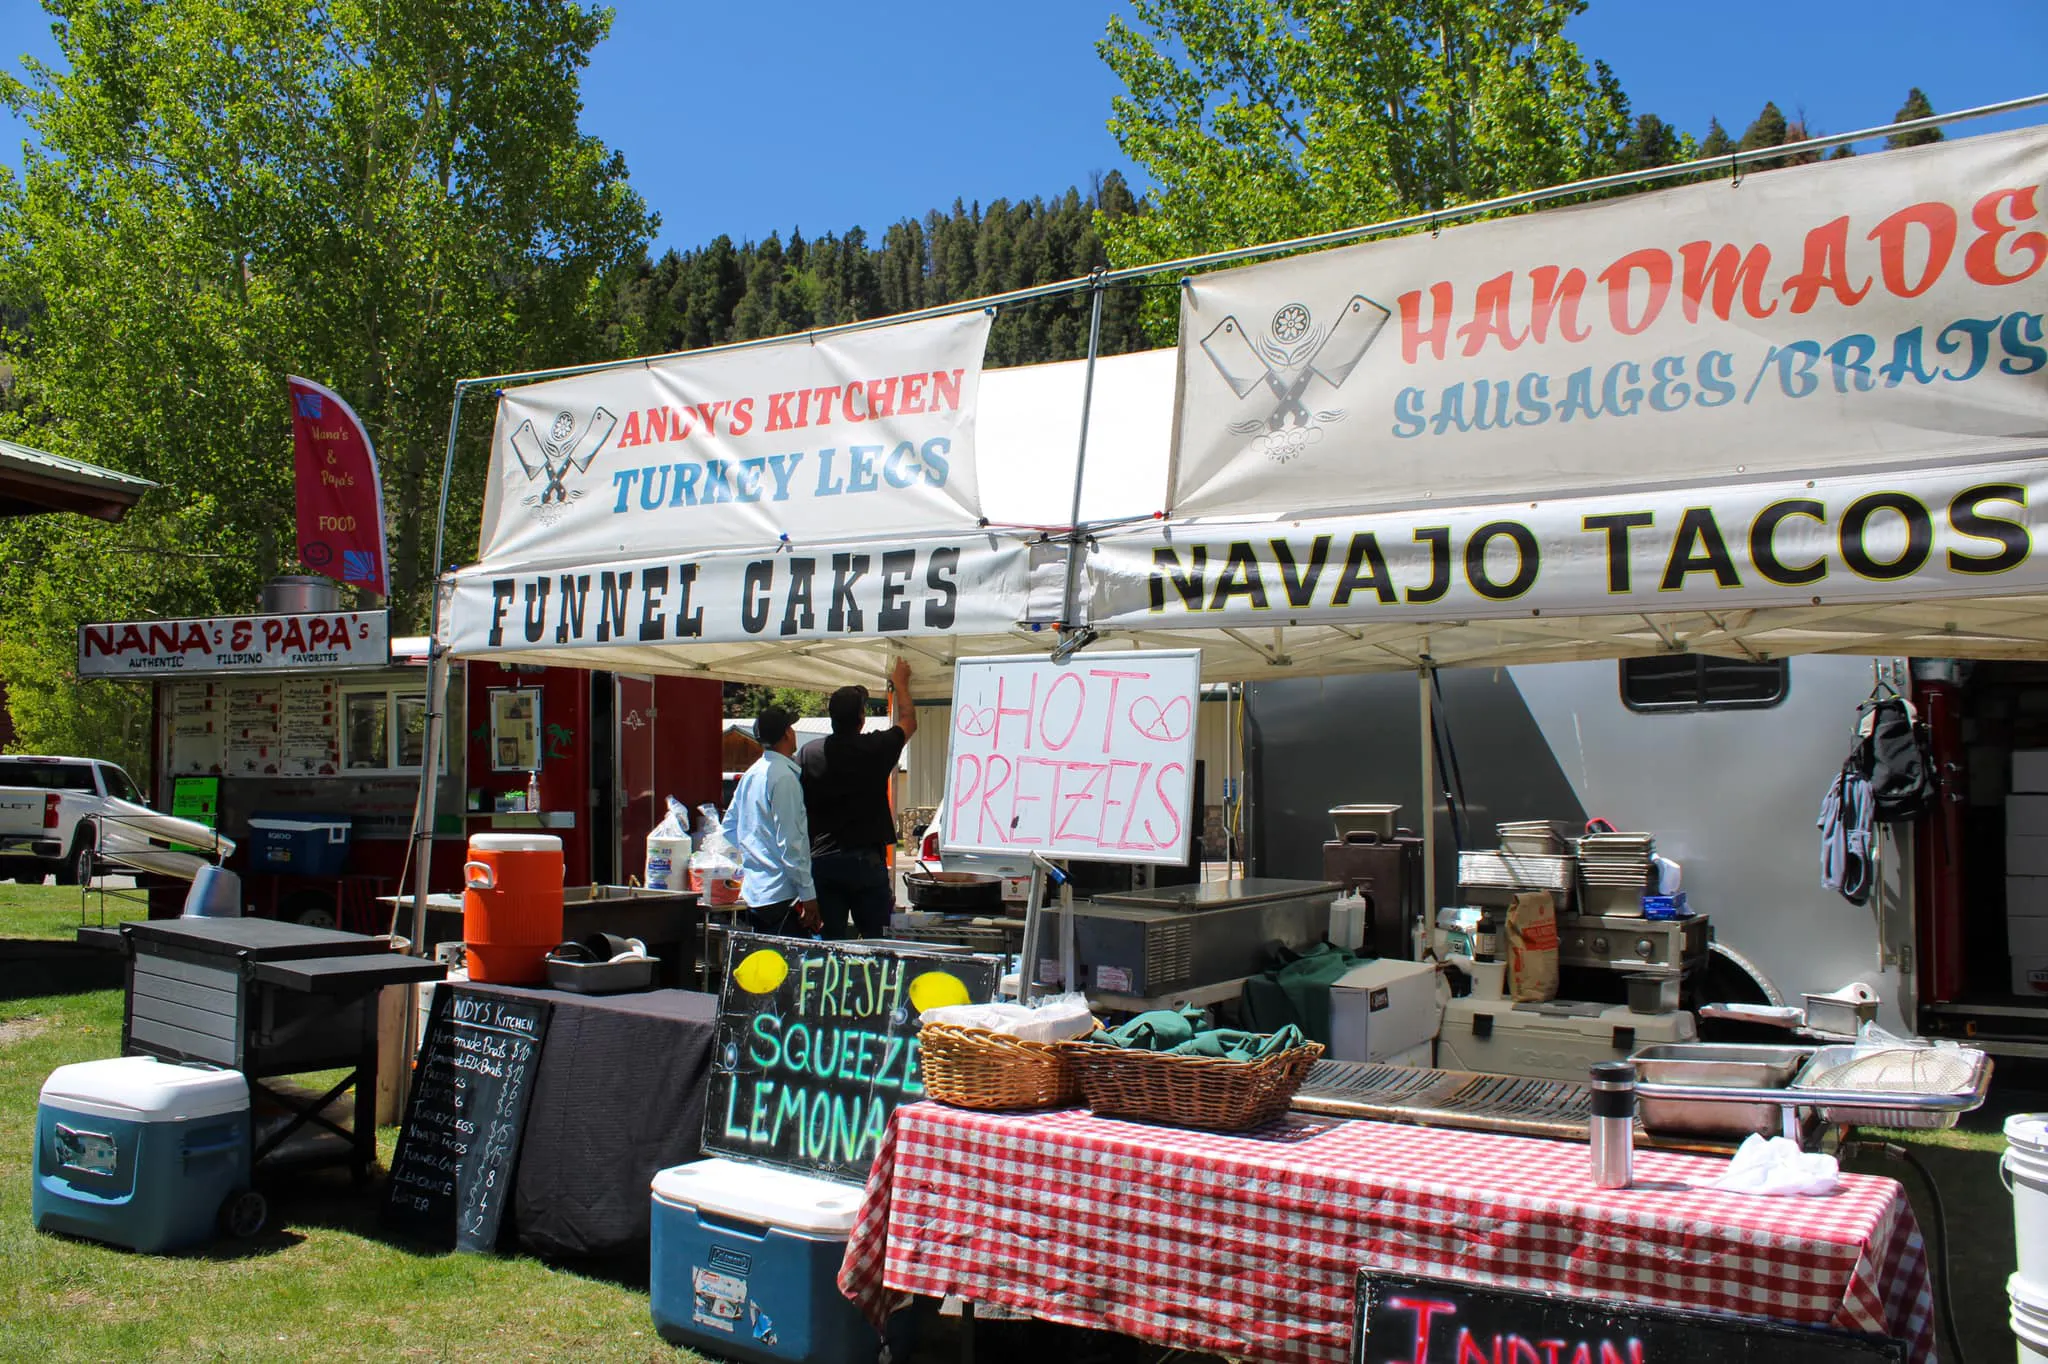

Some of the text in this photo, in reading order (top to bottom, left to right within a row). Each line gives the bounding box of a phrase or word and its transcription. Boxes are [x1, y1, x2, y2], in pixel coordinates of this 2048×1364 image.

[1395, 185, 2048, 366] HANDMADE
[617, 369, 966, 448] ANDY'S KITCHEN
[1391, 310, 2047, 440] SAUSAGES/BRATS
[326, 450, 337, 465] &
[612, 437, 951, 514] TURKEY LEGS
[319, 515, 356, 532] FOOD
[1149, 482, 2033, 614] NAVAJO TACOS
[230, 619, 252, 651] &
[488, 546, 961, 647] FUNNEL CAKES
[129, 652, 339, 668] AUTHENTIC FILIPINO FAVORITES
[993, 669, 1150, 753] HOT
[951, 753, 1185, 851] PRETZELS
[799, 955, 905, 1018] FRESH
[482, 1036, 506, 1058] Brats
[511, 1042, 530, 1061] $10
[506, 1064, 525, 1085] $12
[750, 1013, 924, 1094] SQUEEZE
[1387, 1297, 1645, 1364] INDIAN
